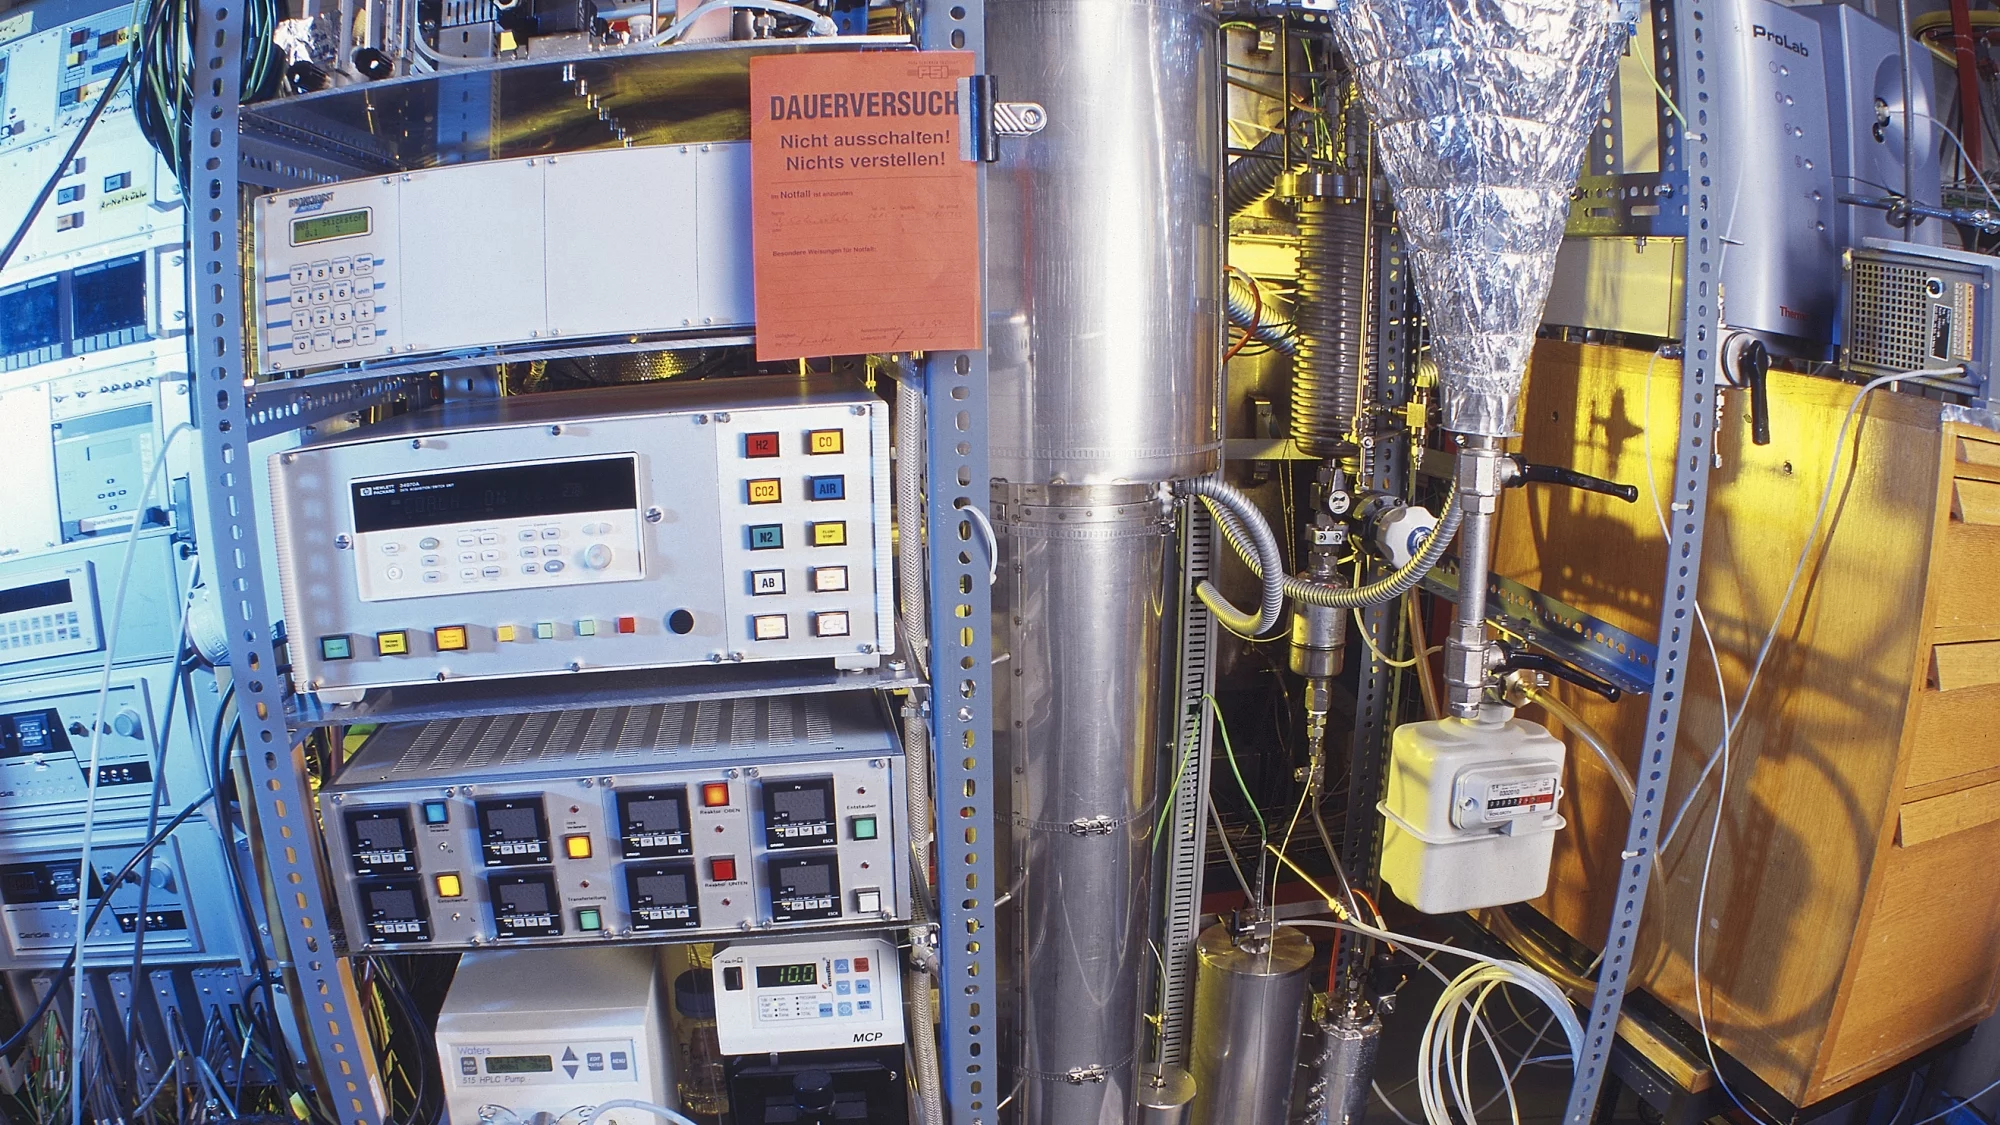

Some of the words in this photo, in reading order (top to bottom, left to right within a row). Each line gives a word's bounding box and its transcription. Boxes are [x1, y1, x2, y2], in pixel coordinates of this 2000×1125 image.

[1752, 24, 1809, 57] ProLab
[918, 65, 949, 79] PSI
[770, 90, 959, 121] DAUERVERSUCH
[780, 134, 828, 149] Nicht
[834, 130, 951, 146] ausschalten!
[786, 155, 845, 171] Nichts
[850, 151, 946, 168] verstellen!
[780, 190, 811, 199] Notfall
[317, 269, 324, 278] 8
[338, 266, 344, 274] 9
[297, 272, 302, 280] 7
[318, 292, 324, 301] 5
[339, 289, 345, 297] 6
[319, 315, 325, 324] 2
[340, 312, 346, 321] 3
[299, 319, 303, 327] 1
[299, 342, 306, 350] 0
[755, 440, 769, 450] H2
[819, 436, 832, 448] CO
[755, 485, 774, 497] CO2
[819, 483, 836, 495] AIR
[760, 532, 773, 543] N2
[762, 577, 775, 588] AB
[779, 964, 815, 983] 10.0
[853, 1032, 883, 1042] MCP
[457, 1047, 492, 1055] Waters
[462, 1076, 476, 1084] 515
[479, 1075, 500, 1084] HPLC
[504, 1075, 525, 1084] Pump
